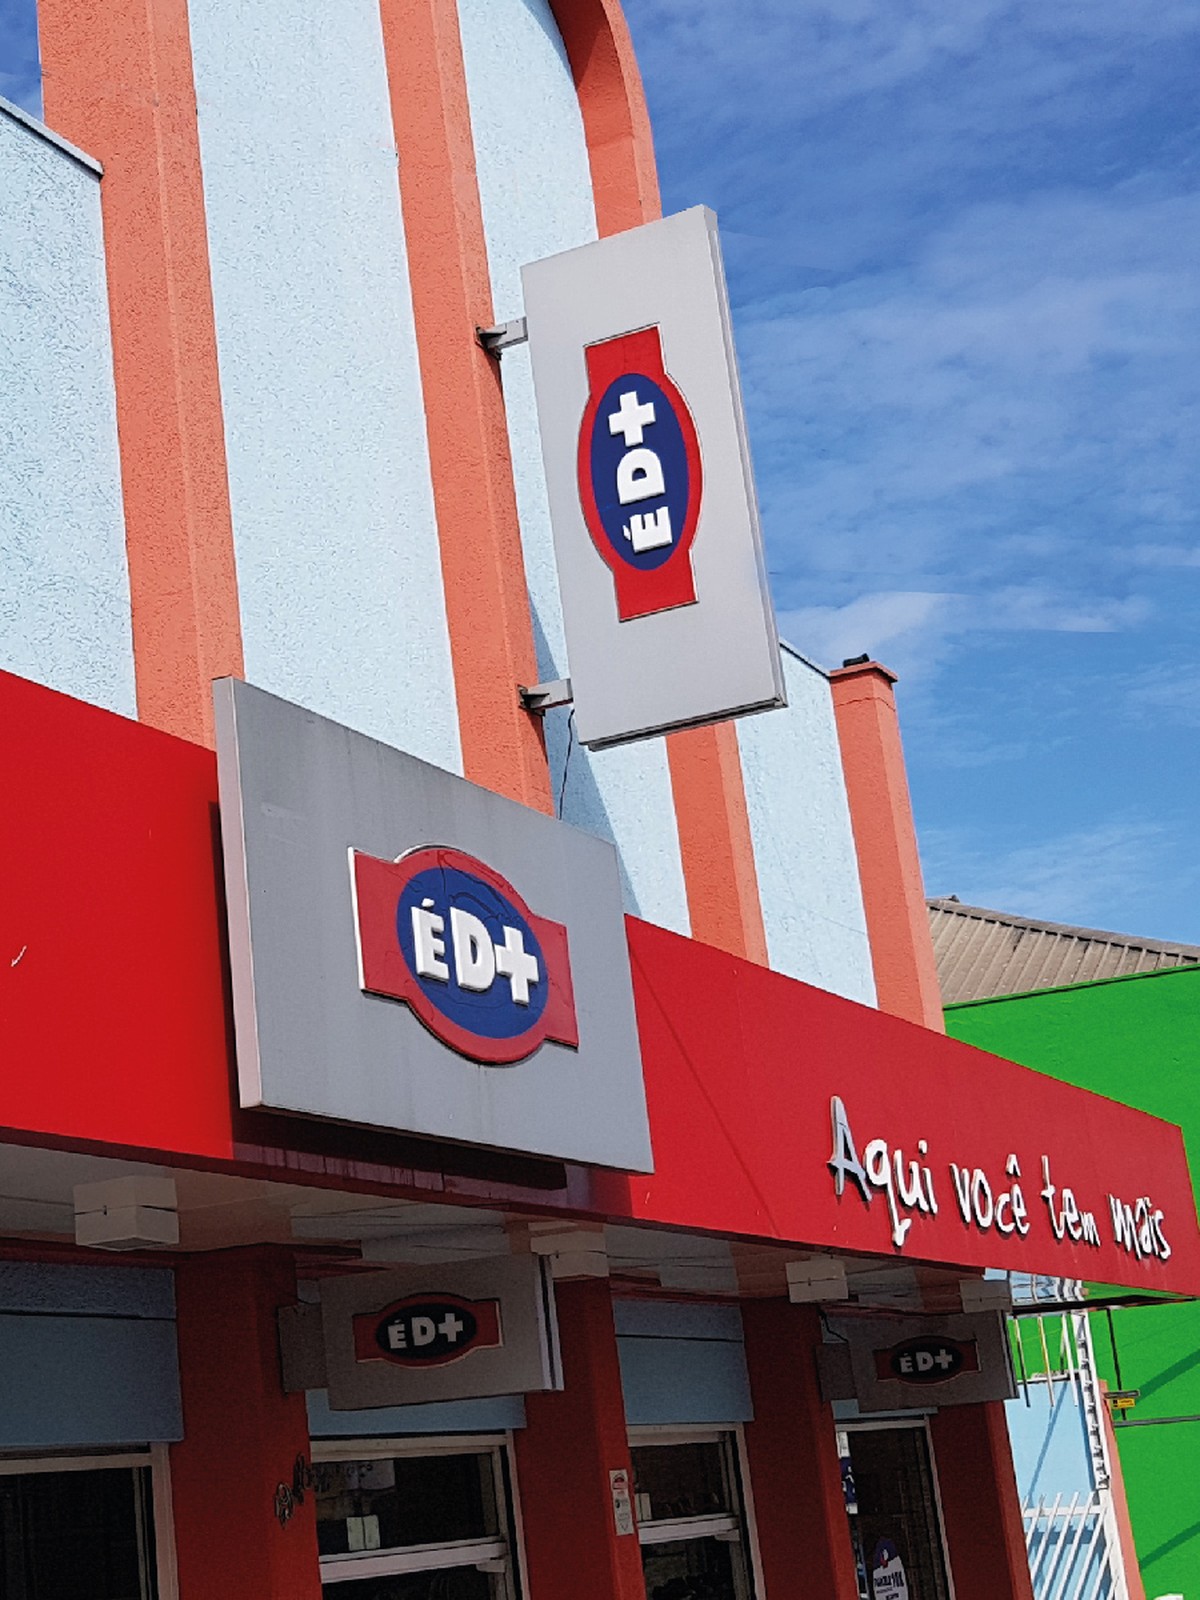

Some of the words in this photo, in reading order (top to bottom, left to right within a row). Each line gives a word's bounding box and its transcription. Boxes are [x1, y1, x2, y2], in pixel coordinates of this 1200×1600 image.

[827, 1095, 938, 1247] Aqui
[949, 1154, 1030, 1235] você
[1040, 1155, 1100, 1246] tem
[1107, 1193, 1172, 1261] mais
